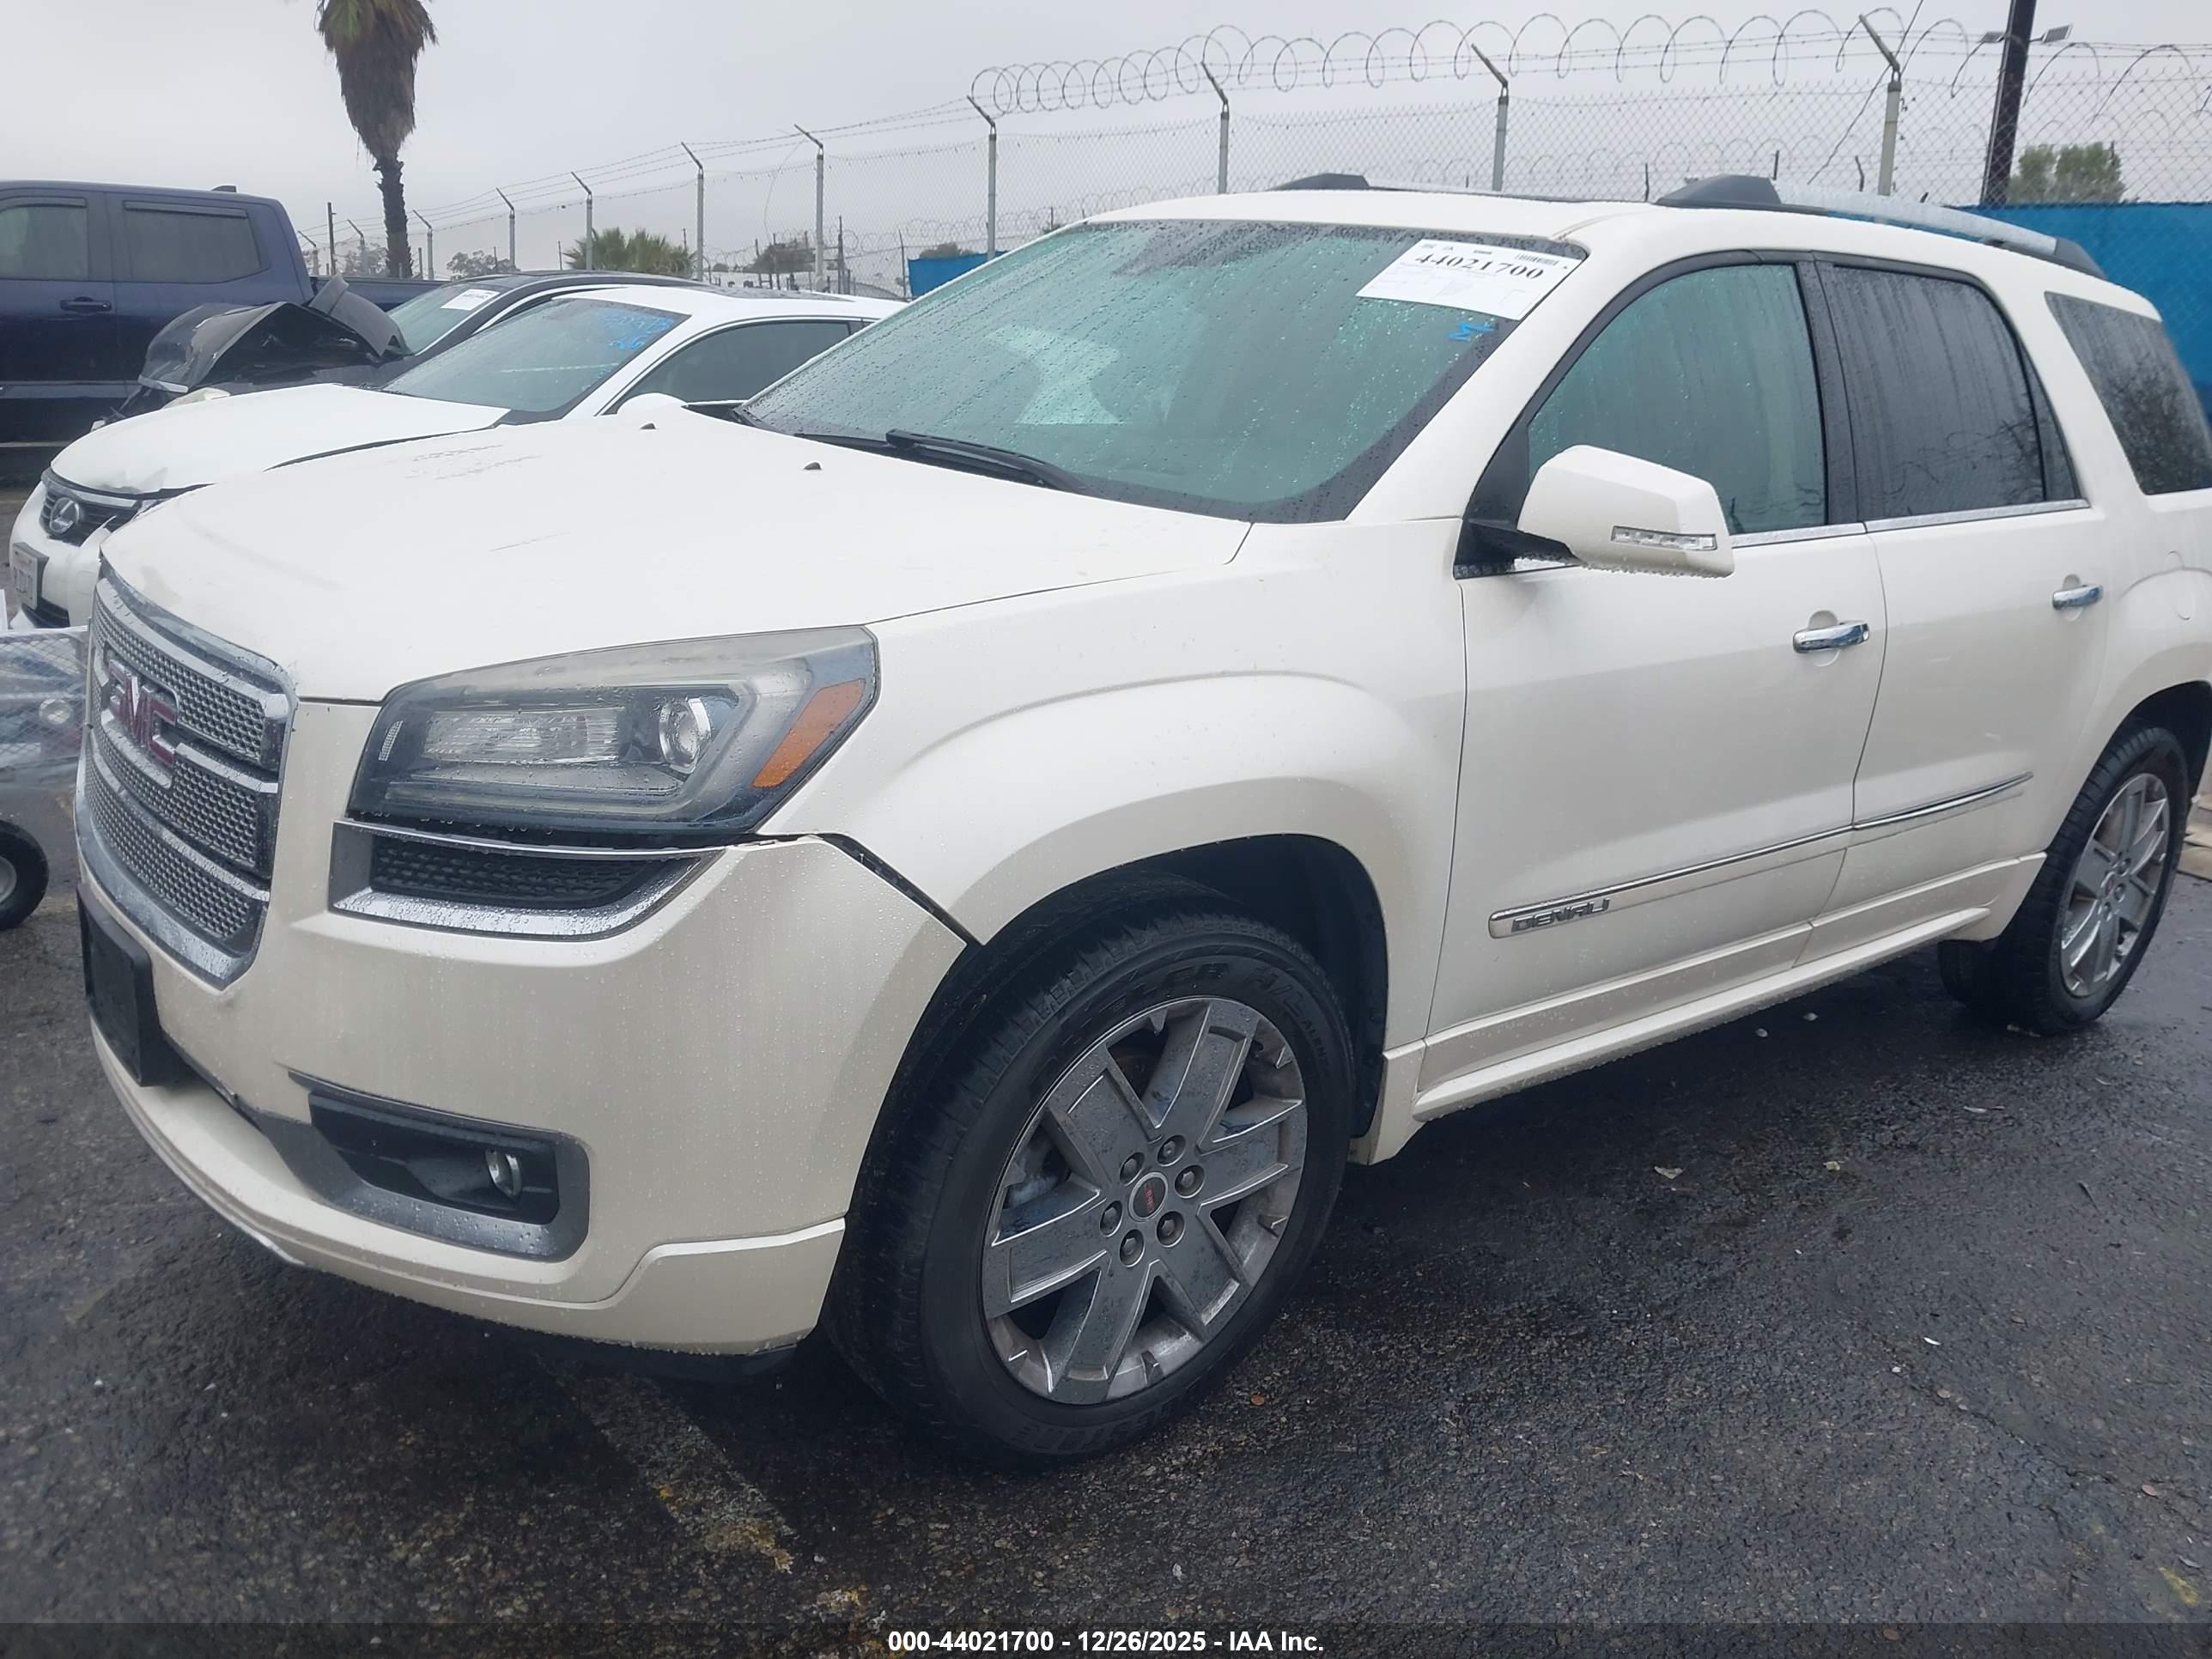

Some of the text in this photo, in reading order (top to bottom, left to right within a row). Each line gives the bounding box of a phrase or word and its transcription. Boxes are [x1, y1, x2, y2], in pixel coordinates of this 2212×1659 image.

[1416, 253, 1544, 279] 44021700
[109, 660, 177, 765] GMC
[1510, 898, 1611, 933] DENALI
